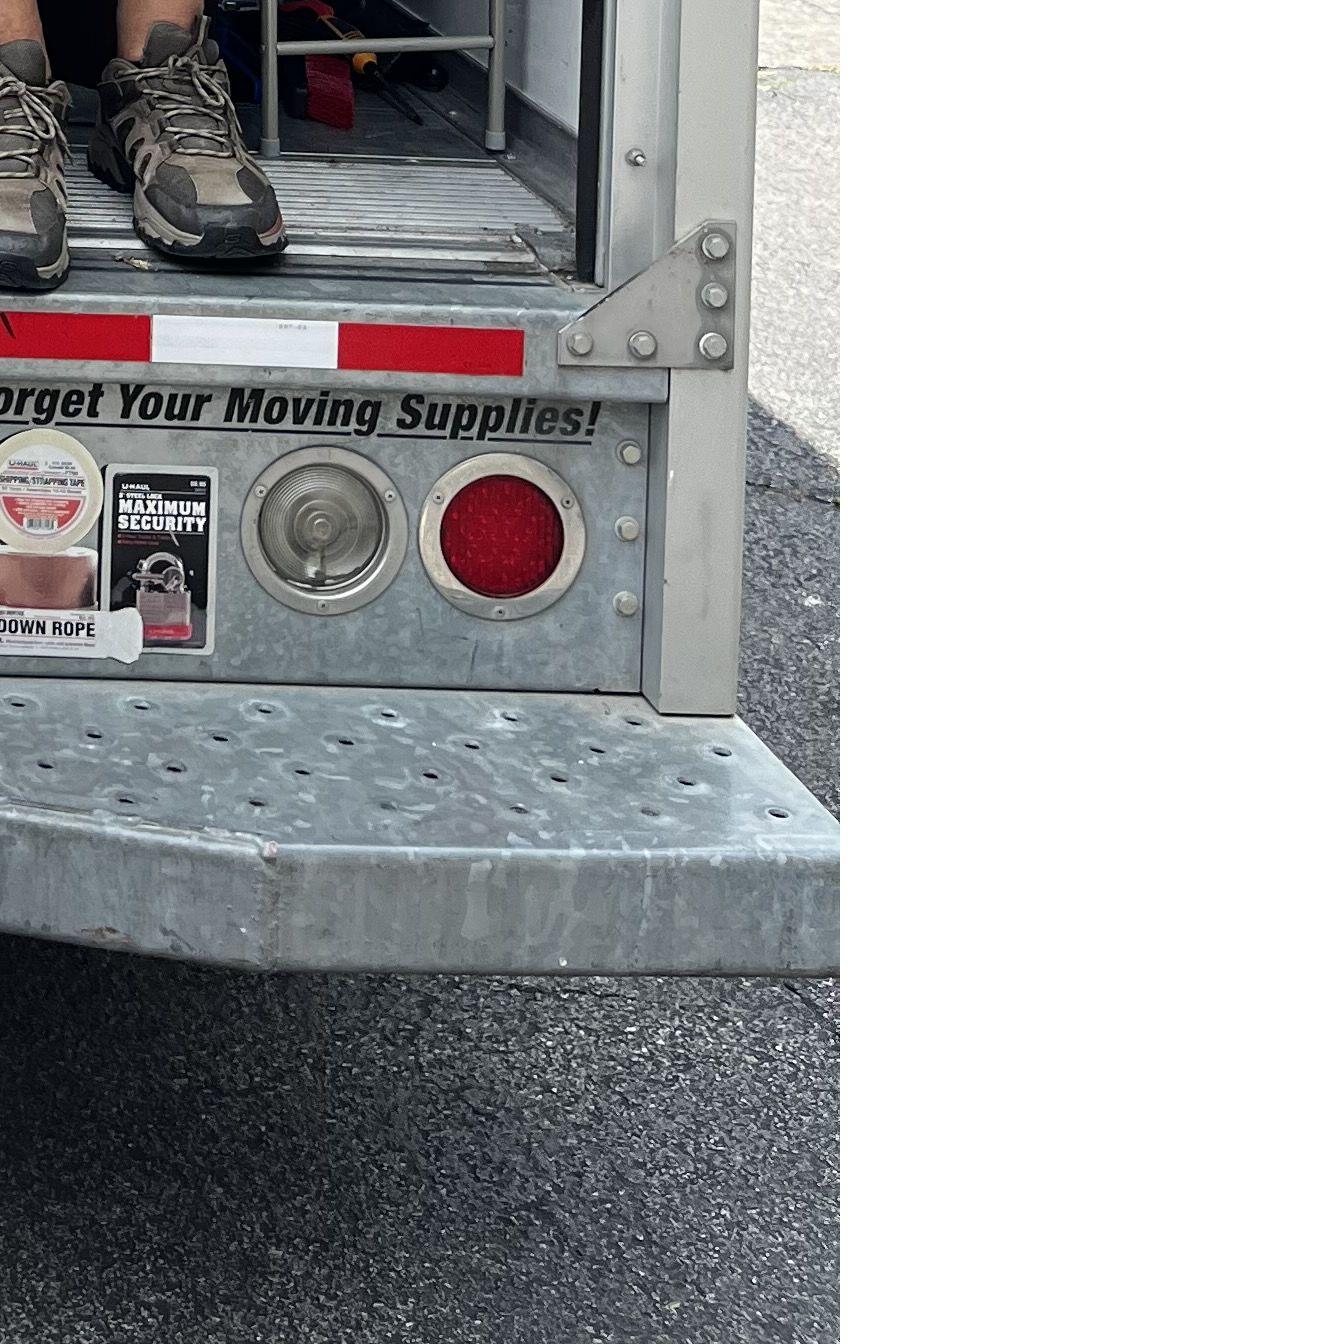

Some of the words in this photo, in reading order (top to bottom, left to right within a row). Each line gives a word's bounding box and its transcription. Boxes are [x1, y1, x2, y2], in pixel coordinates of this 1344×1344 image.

[119, 383, 213, 423] Your
[223, 387, 383, 437] Moving
[395, 393, 603, 441] Supplies!
[69, 478, 86, 488] TAPE
[121, 483, 150, 491] U-HAUL
[118, 498, 206, 517] MAXIMUM
[117, 514, 207, 532] SECURITY
[51, 620, 97, 638] ROPE
